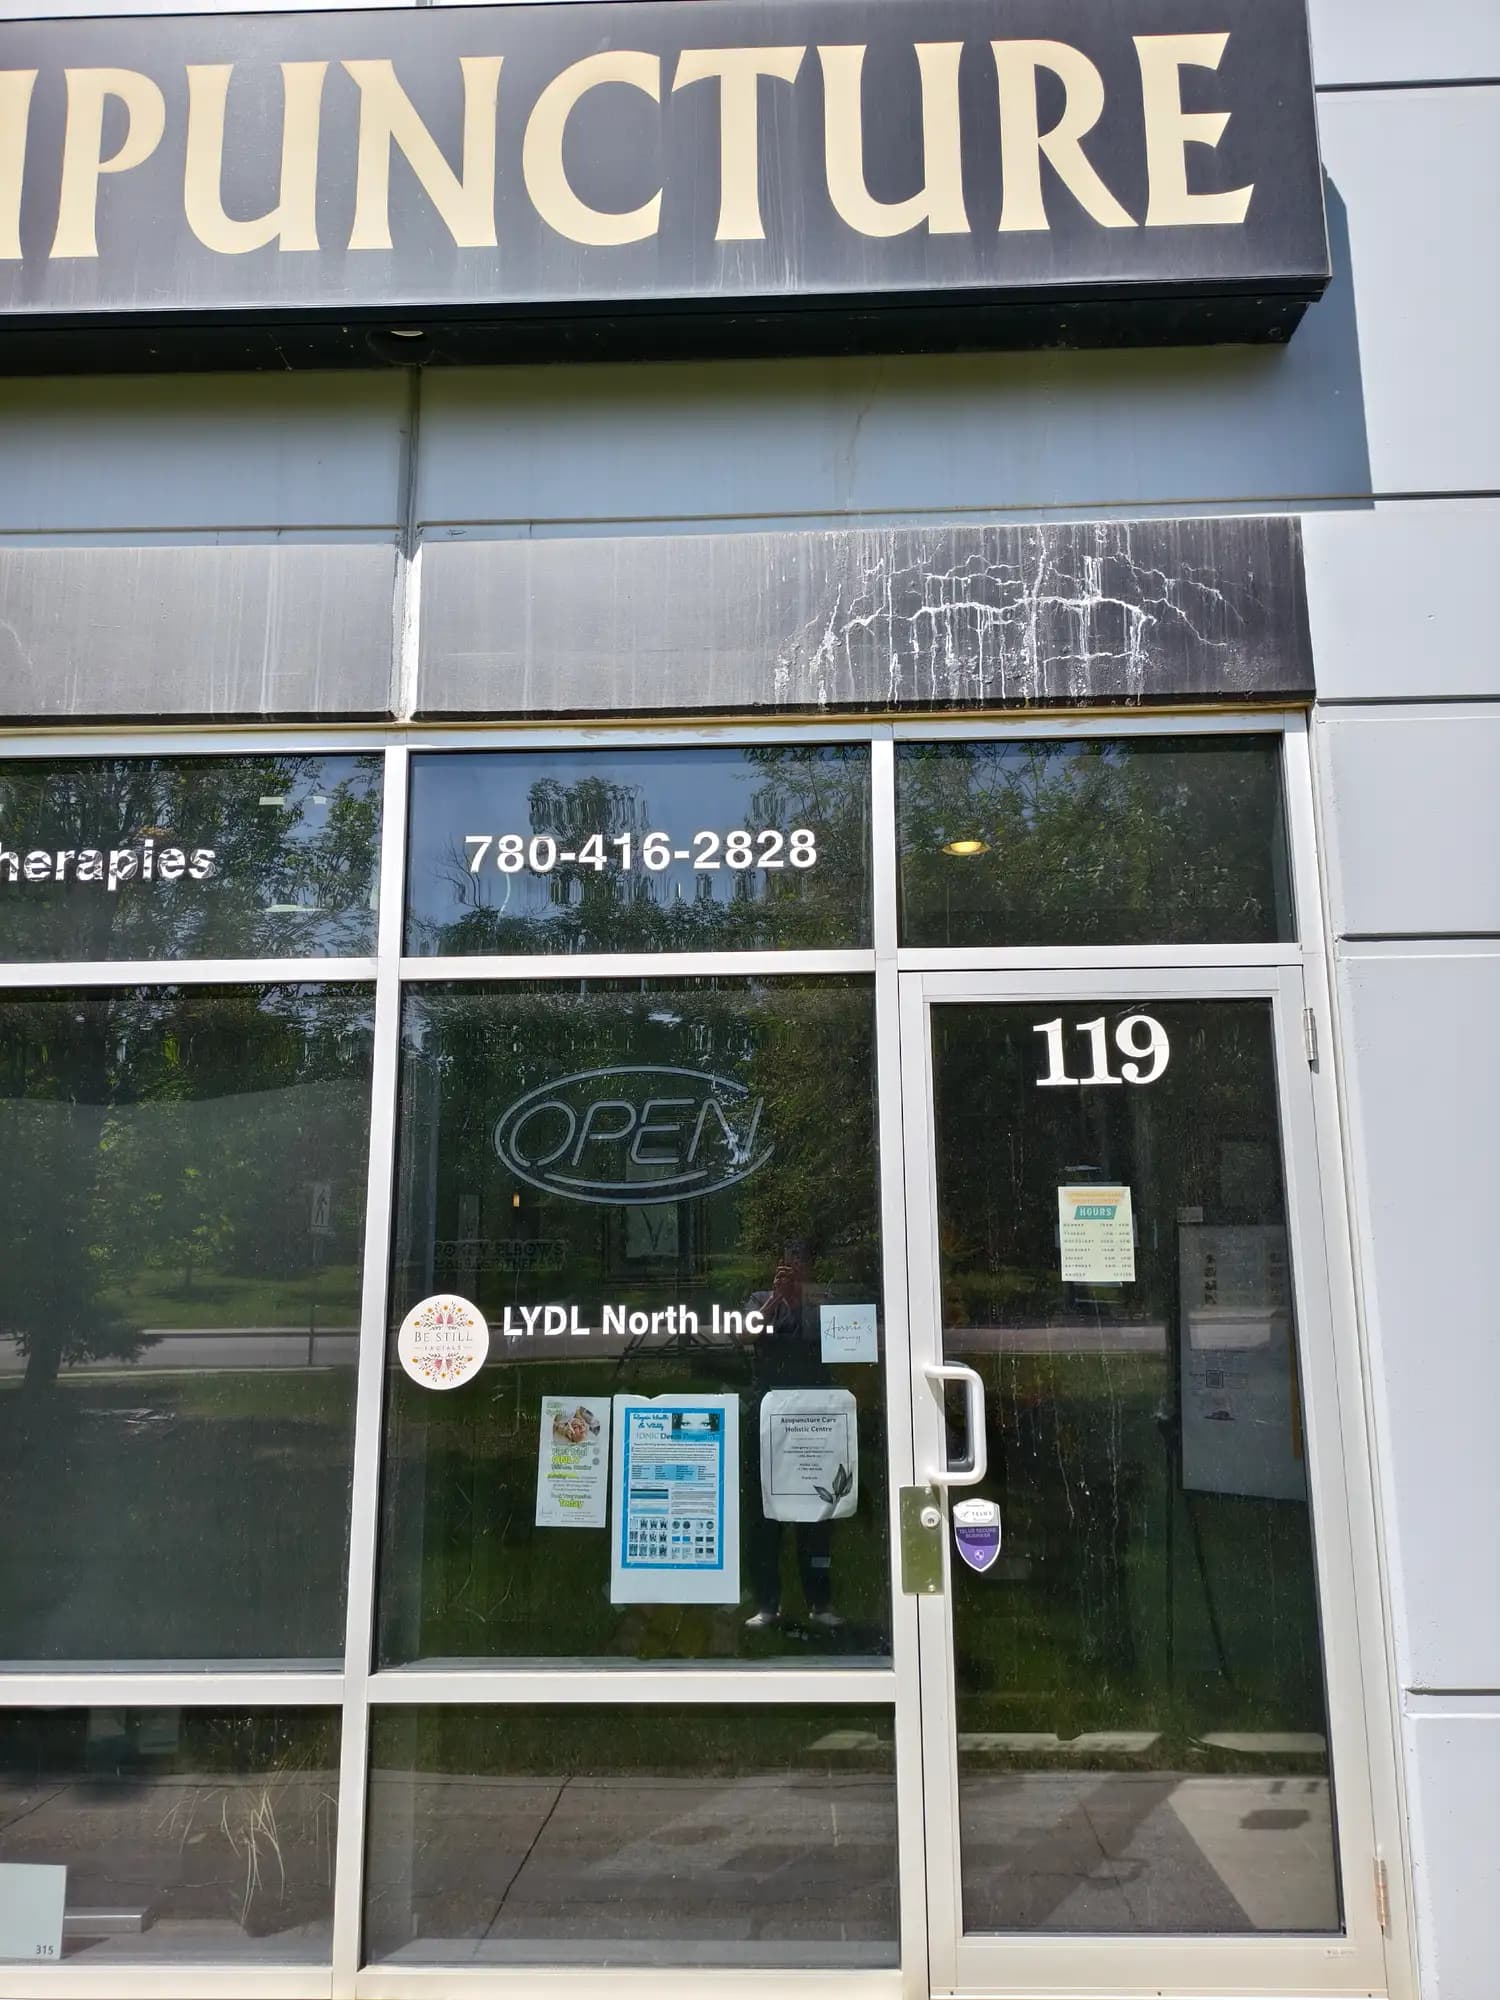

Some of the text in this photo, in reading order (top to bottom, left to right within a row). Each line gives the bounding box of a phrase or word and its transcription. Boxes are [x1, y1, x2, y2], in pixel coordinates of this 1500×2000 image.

[0, 32, 1254, 260] PUNCTURE
[465, 829, 818, 873] 780-416-2828
[1032, 1015, 1171, 1087] 119
[509, 1096, 764, 1168] OPEN
[1079, 1206, 1113, 1217] HOURS
[414, 1331, 473, 1343] BE STILL
[503, 1303, 775, 1338] LYDL North Inc.
[35, 1943, 54, 1956] 315
